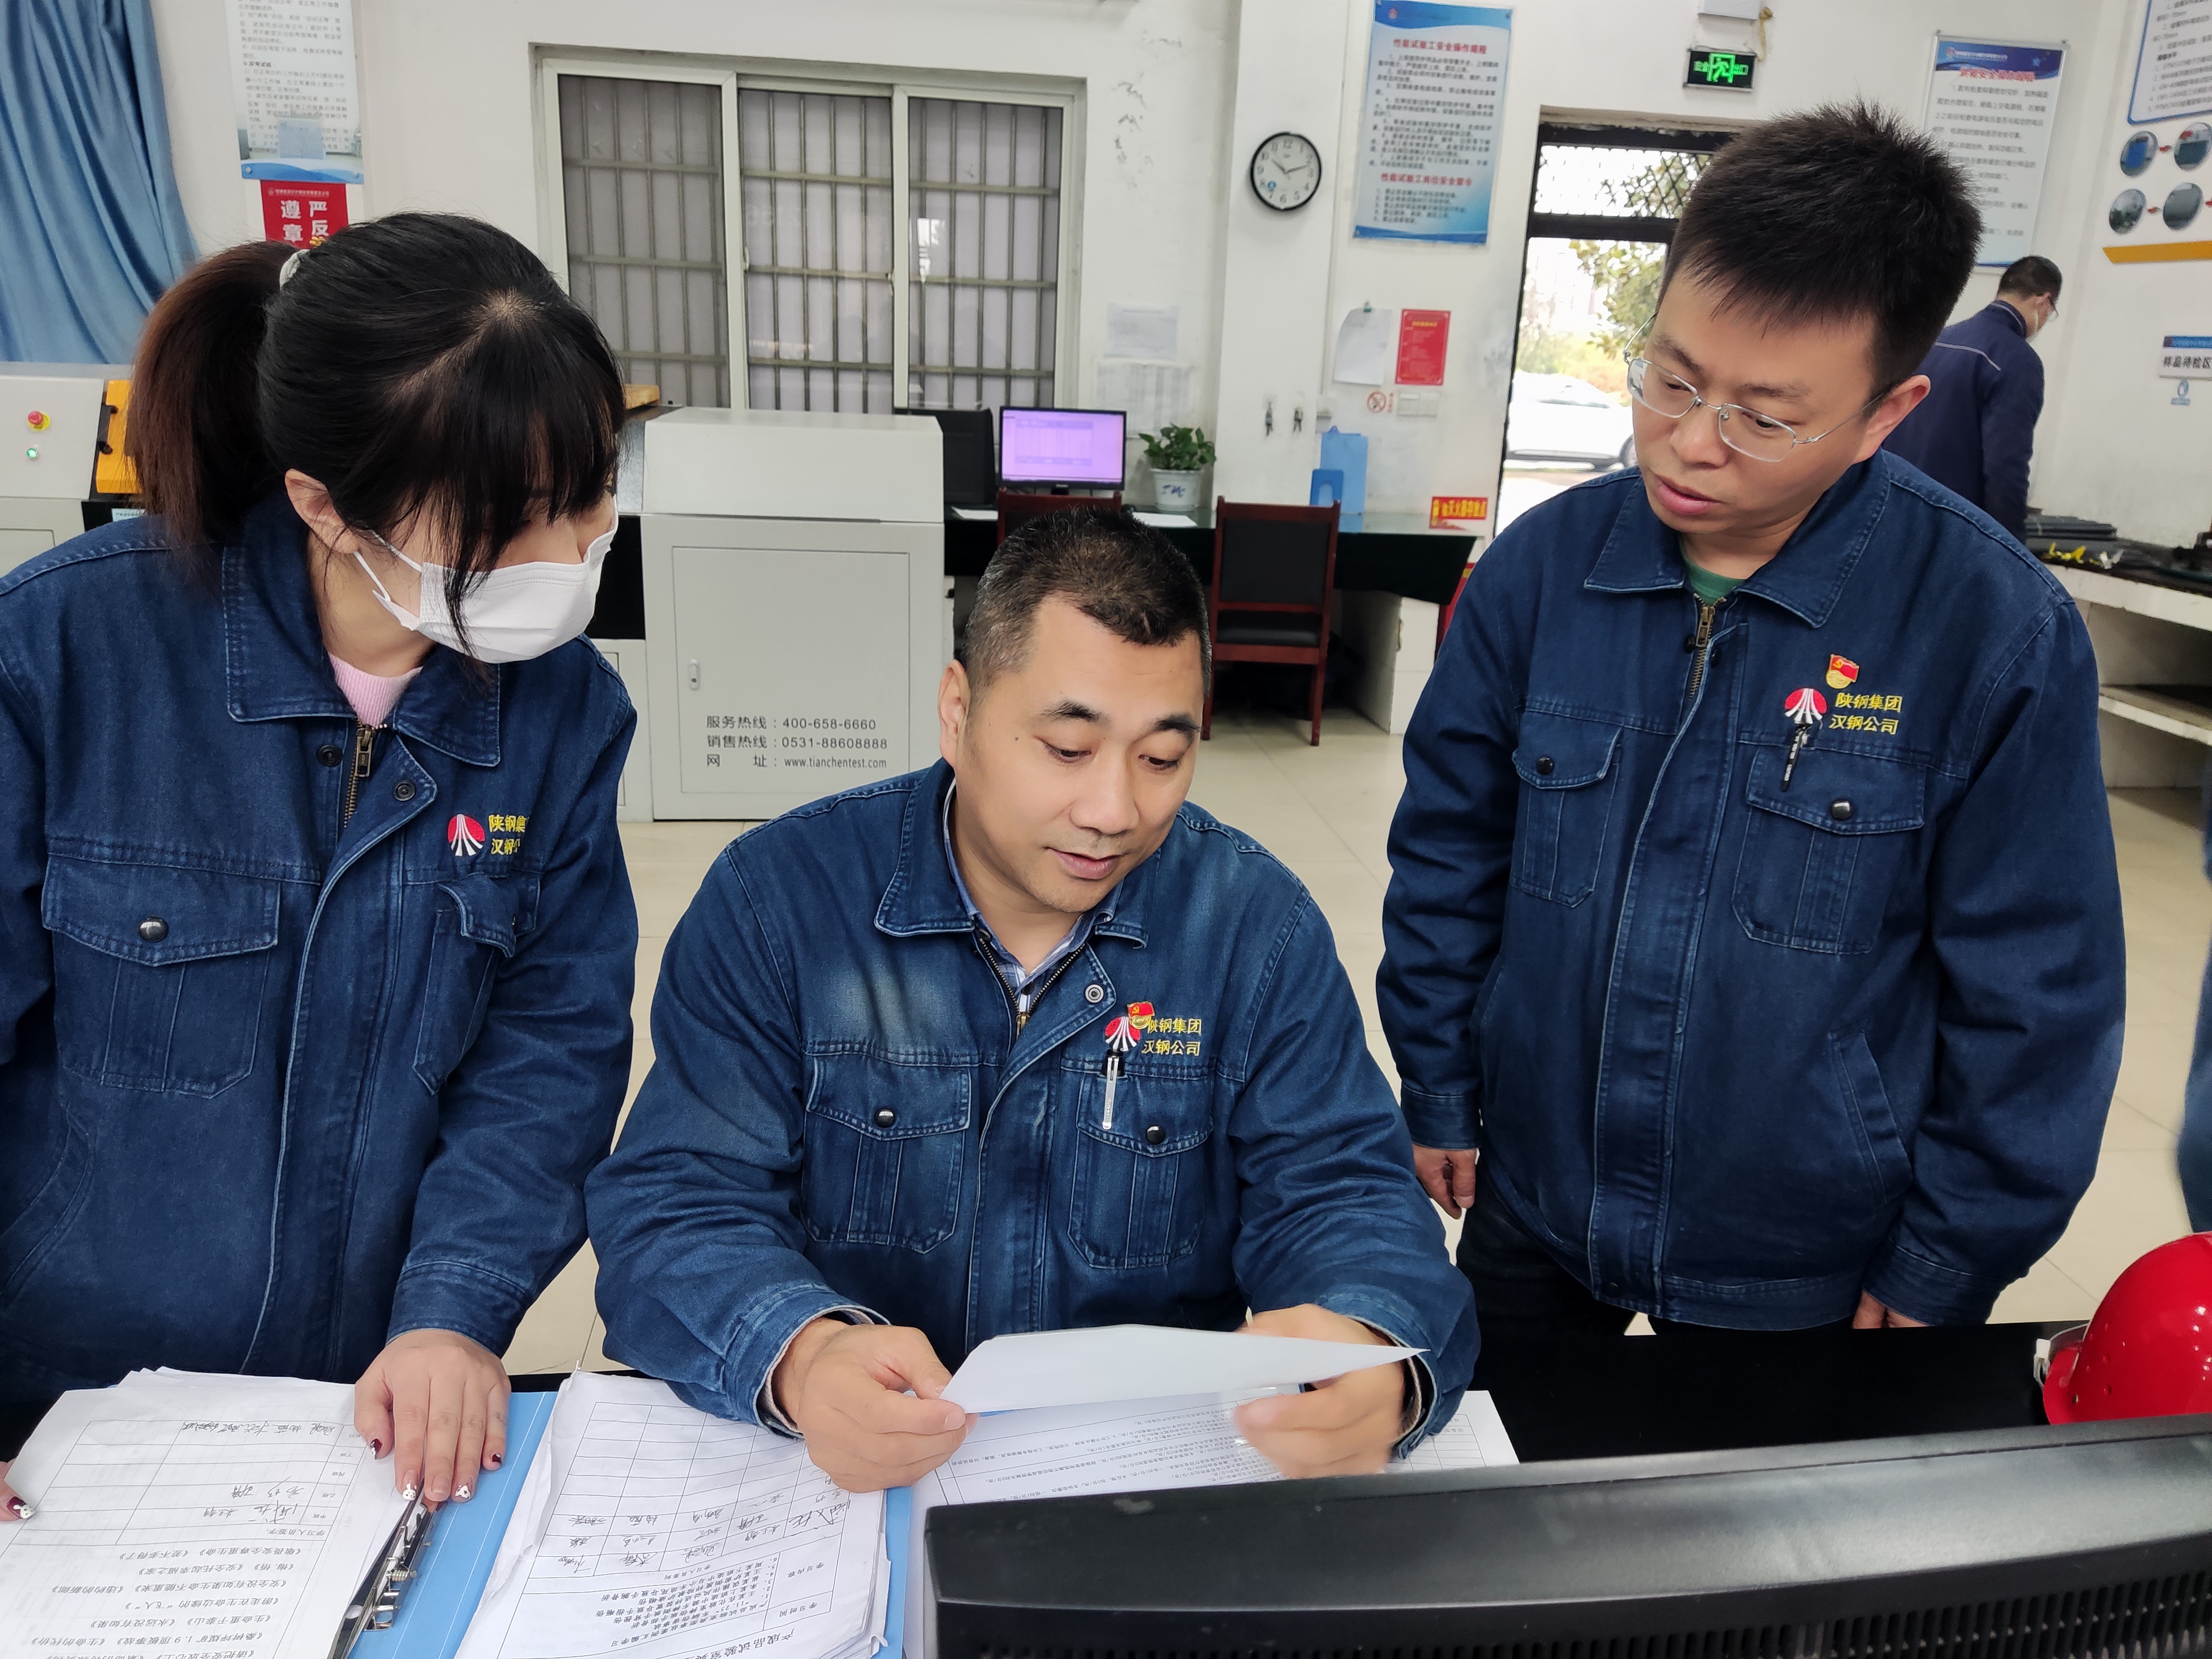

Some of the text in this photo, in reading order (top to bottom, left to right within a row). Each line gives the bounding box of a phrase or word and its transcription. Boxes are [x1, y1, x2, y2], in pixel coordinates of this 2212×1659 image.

[1835, 692, 1903, 713] 陕钢集团
[782, 718, 877, 730] 400-658-6660
[1828, 714, 1899, 735] 汉钢公司
[782, 737, 888, 749] 0531-88608888
[784, 756, 887, 769] www.tianchentest.com
[488, 814, 528, 833] 陕钢集
[1147, 1018, 1202, 1036] 陕钢集团
[1141, 1039, 1201, 1056] 汉钢公司
[119, 1547, 301, 1560] 《敬畏安全尊重生命》 《差不多得了》
[139, 1563, 243, 1575] 《安全托起幸福之家》
[134, 1579, 286, 1593] 《安全没有如果生命不能重来》
[779, 1602, 817, 1618] 学习时间
[91, 1615, 271, 1628] 《生命重于泰山》 《永远没有如果》
[32, 1637, 105, 1646] 《生命的代价》
